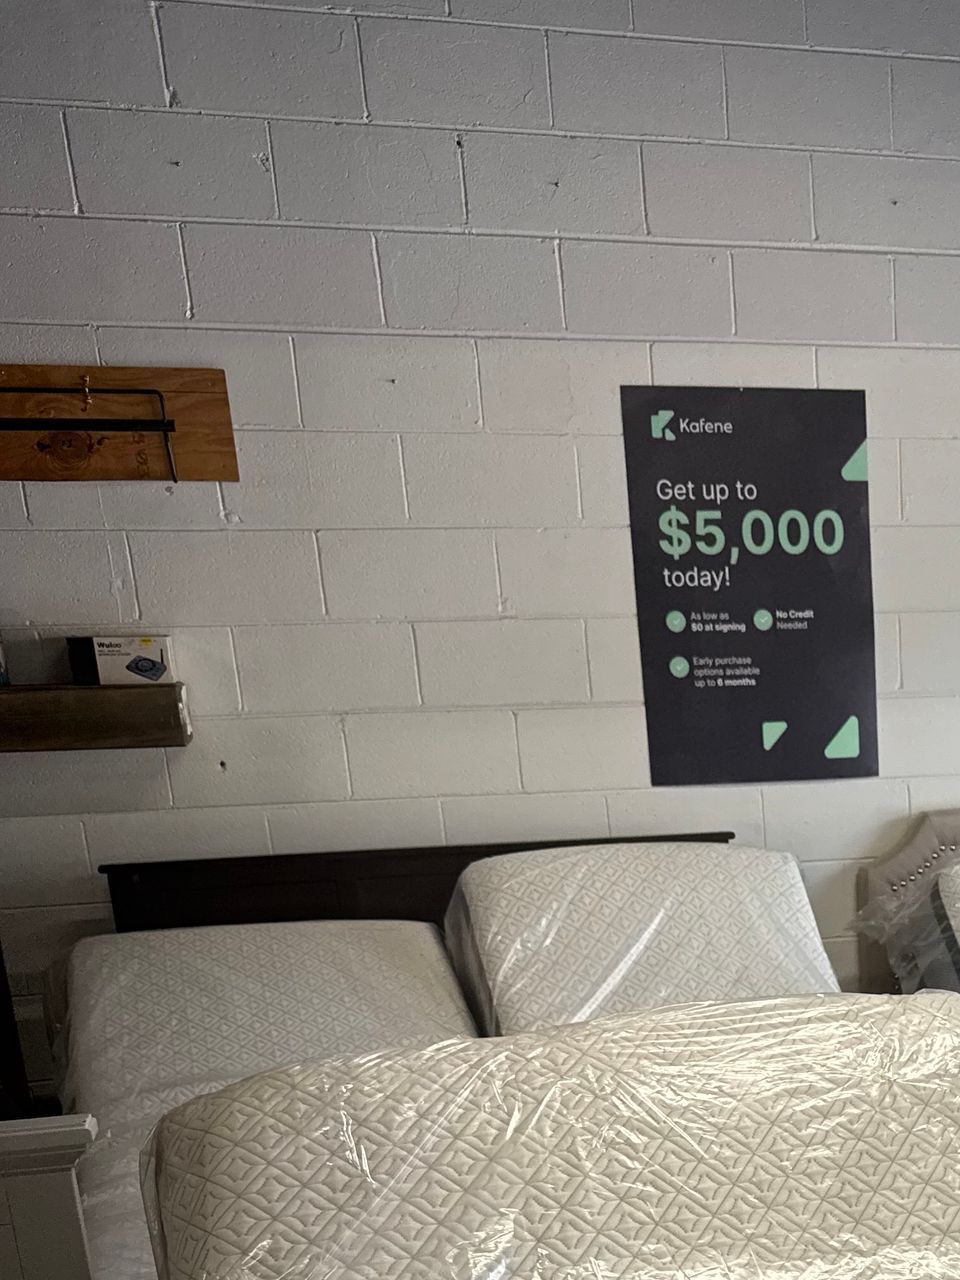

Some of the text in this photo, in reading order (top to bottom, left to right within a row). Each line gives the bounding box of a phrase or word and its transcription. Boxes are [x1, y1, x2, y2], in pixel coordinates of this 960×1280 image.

[679, 417, 734, 434] Kafene
[656, 479, 758, 505] Get up to
[658, 505, 845, 565] $5,000
[662, 566, 731, 591] today!
[690, 611, 729, 620] As low as
[776, 609, 814, 619] No Credit
[691, 622, 746, 633] $0 at signing
[776, 621, 808, 630] Needed
[692, 656, 752, 667] Early purchase
[693, 667, 760, 678] options available
[694, 678, 757, 688] up to 6 months
